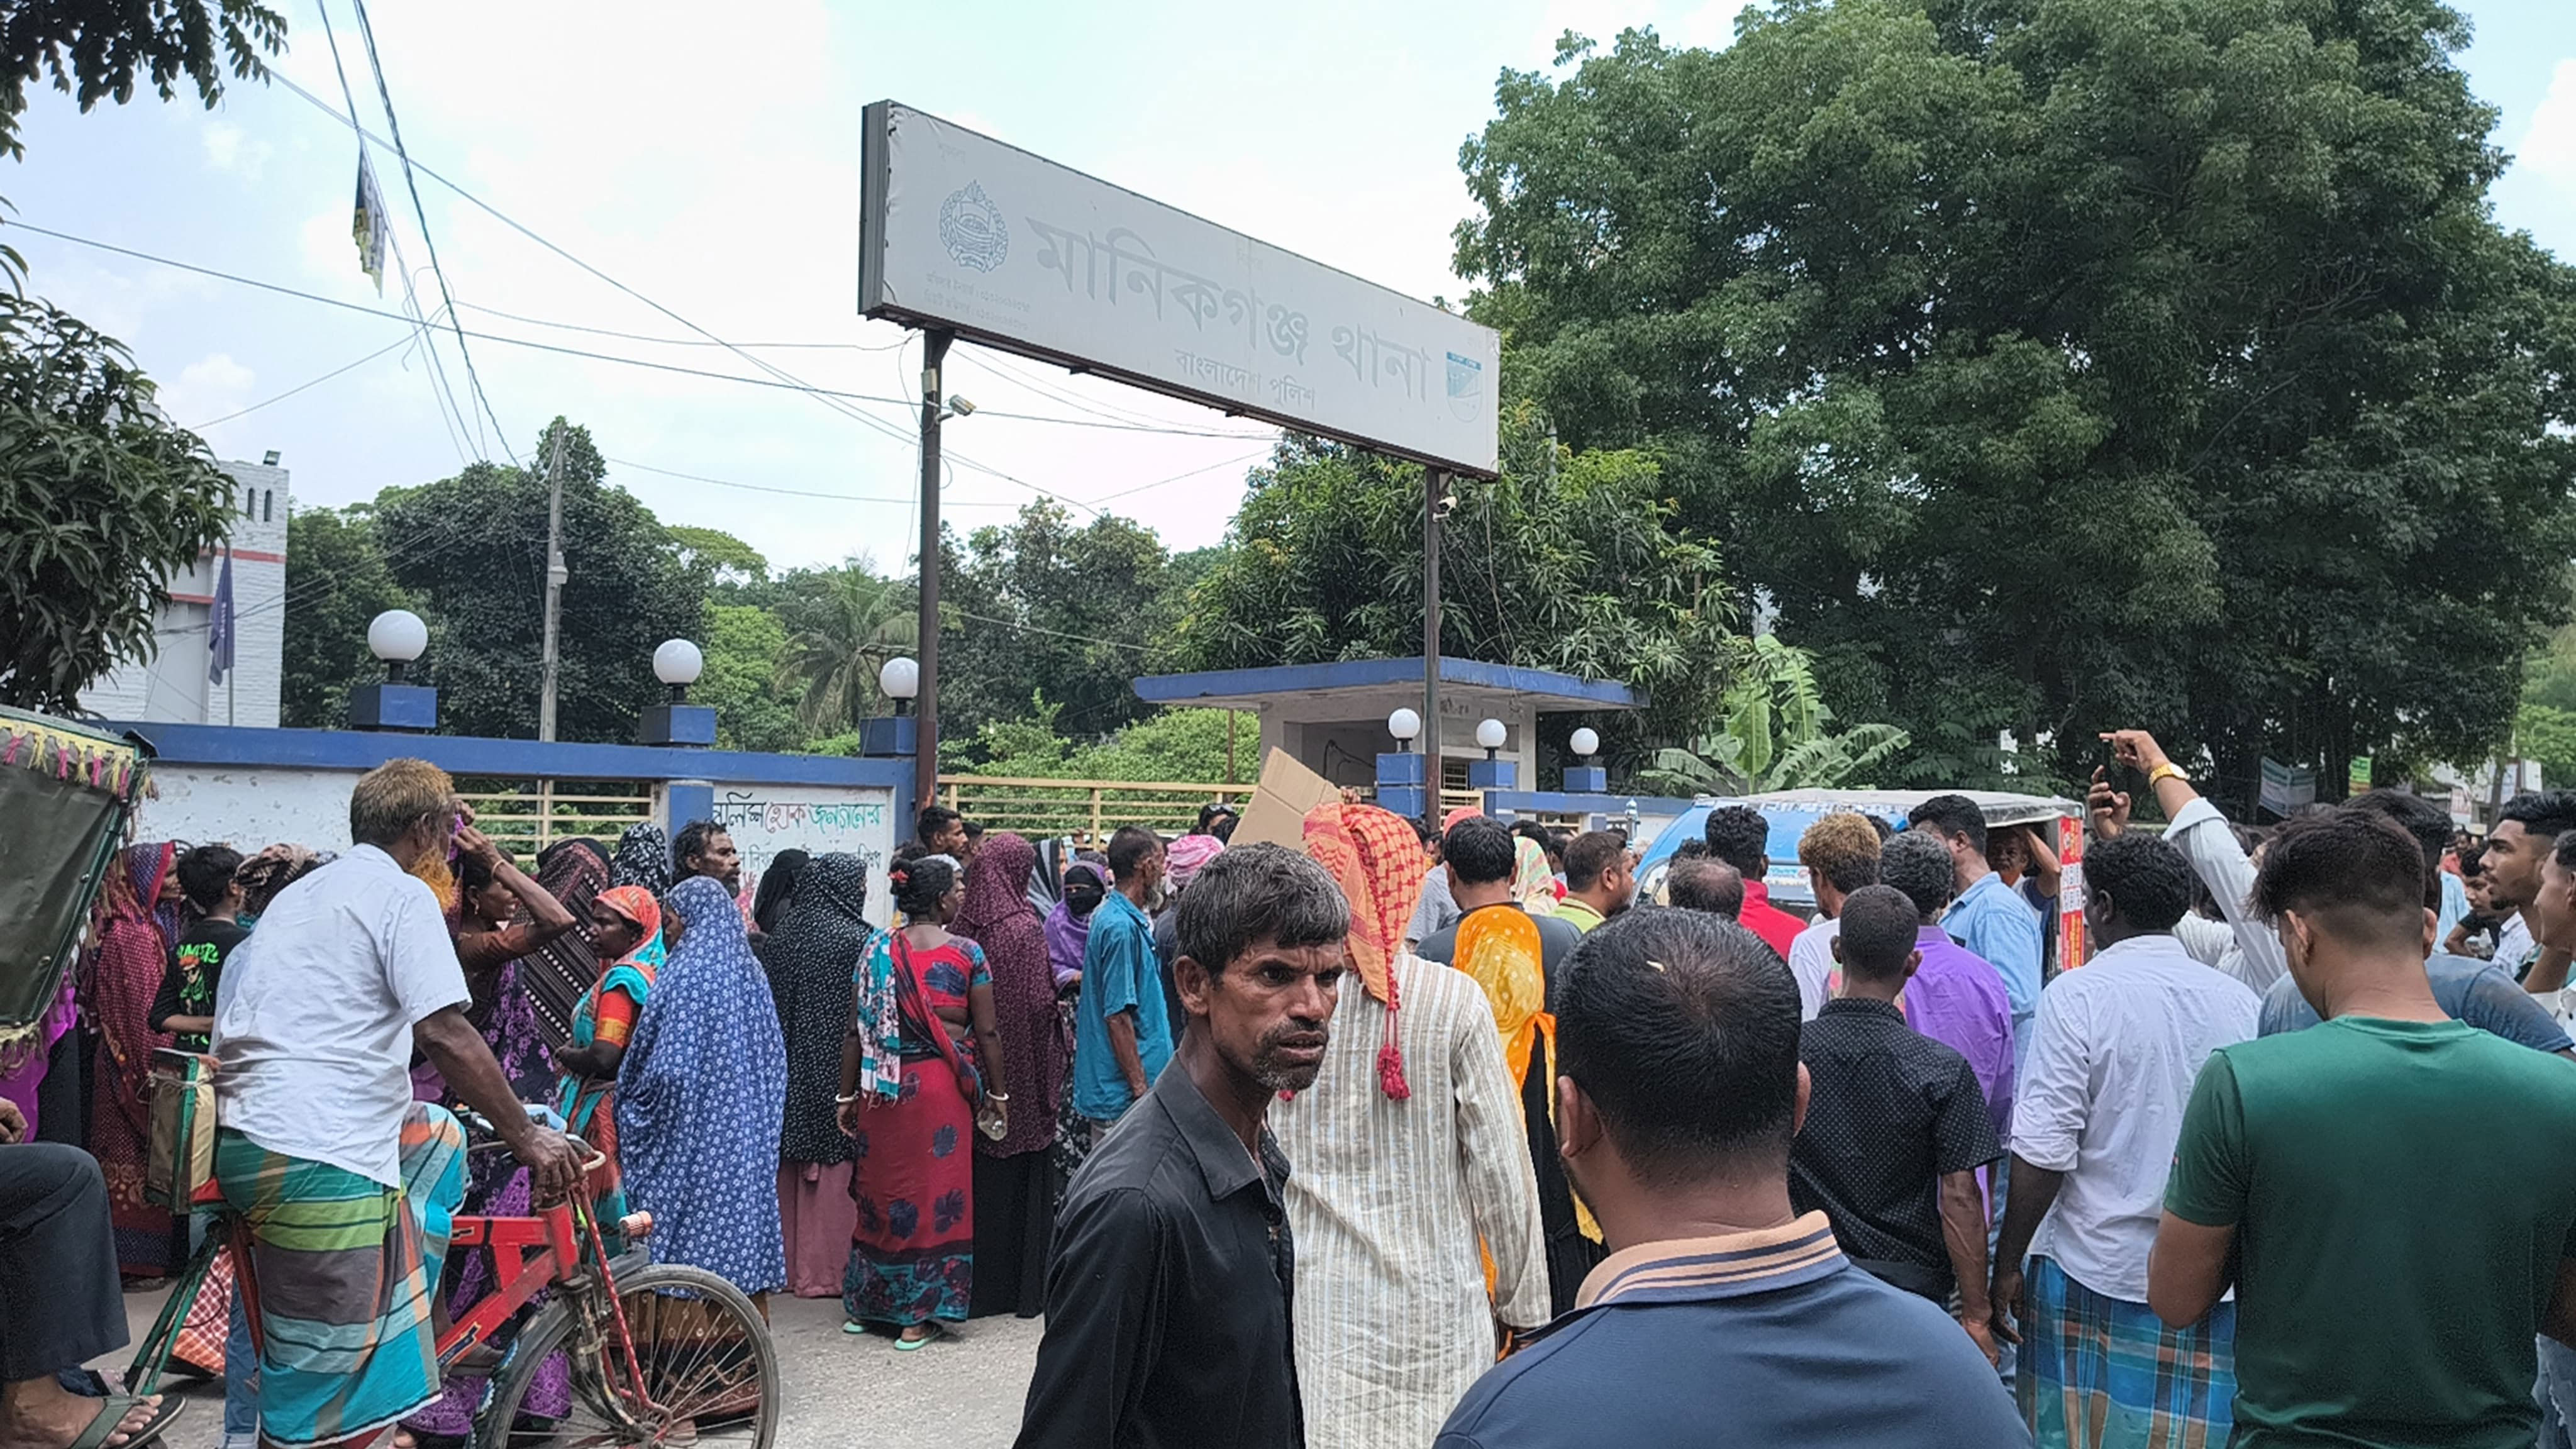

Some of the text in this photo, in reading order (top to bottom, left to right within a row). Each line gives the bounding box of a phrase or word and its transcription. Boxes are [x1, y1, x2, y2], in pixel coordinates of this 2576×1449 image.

[1024, 217, 1432, 404] মানিকগঞ্জ থানা
[1174, 348, 1316, 411] বাংলাদেশ পুলিশ
[767, 802, 807, 833] হোক
